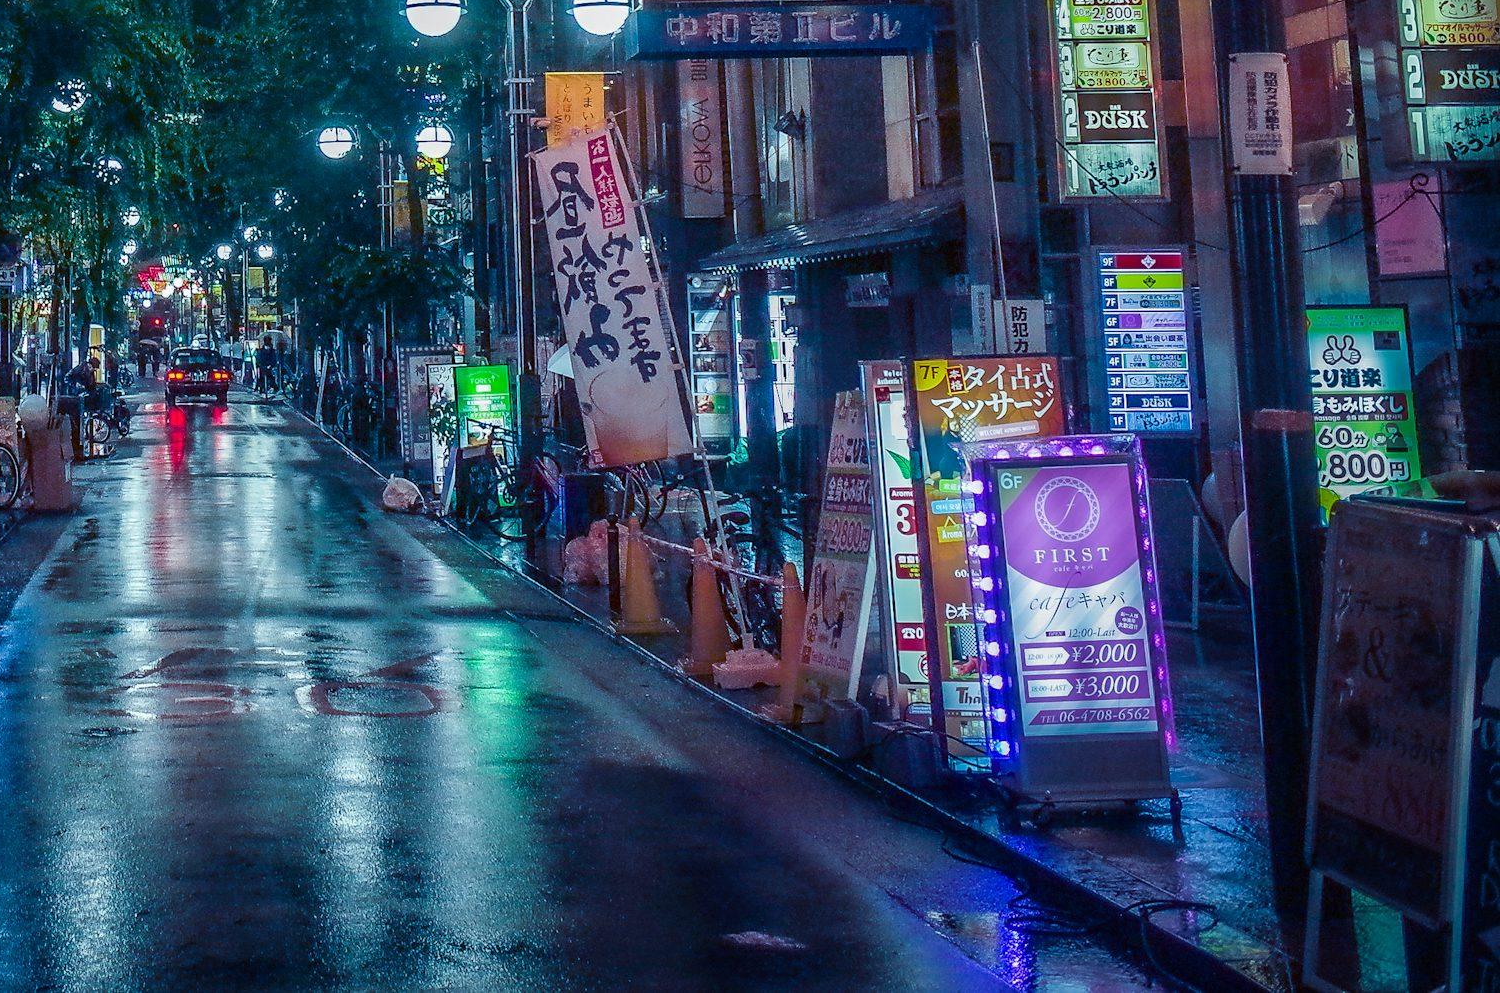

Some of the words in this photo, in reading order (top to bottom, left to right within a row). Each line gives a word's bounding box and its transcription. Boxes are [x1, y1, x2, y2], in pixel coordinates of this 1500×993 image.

[1097, 24, 1137, 35] こり道楽
[1407, 55, 1422, 98] 2
[1065, 97, 1078, 138] 2
[1084, 109, 1148, 130] DUSK
[1412, 112, 1425, 155] 1
[1102, 257, 1113, 267] 9F
[1104, 278, 1114, 287] 8F
[1105, 298, 1116, 307] 7F
[1106, 318, 1117, 326] 6F
[1108, 337, 1119, 346] 5F
[1109, 357, 1120, 366] 4F
[919, 365, 940, 380] 7F
[949, 369, 963, 392] 本格
[963, 362, 1055, 391] タイ古式
[1110, 377, 1121, 386] 3F
[931, 388, 1055, 421] マッサージ
[1111, 397, 1122, 406] 2F
[1113, 417, 1123, 425] 1F
[1318, 427, 1368, 447] 60分
[1000, 472, 1022, 490] 6F
[1034, 547, 1110, 564] FIRST
[1072, 643, 1137, 665] ¥2,000
[1075, 675, 1140, 697] ¥3,000
[1060, 707, 1150, 723] 06-4708-6562
